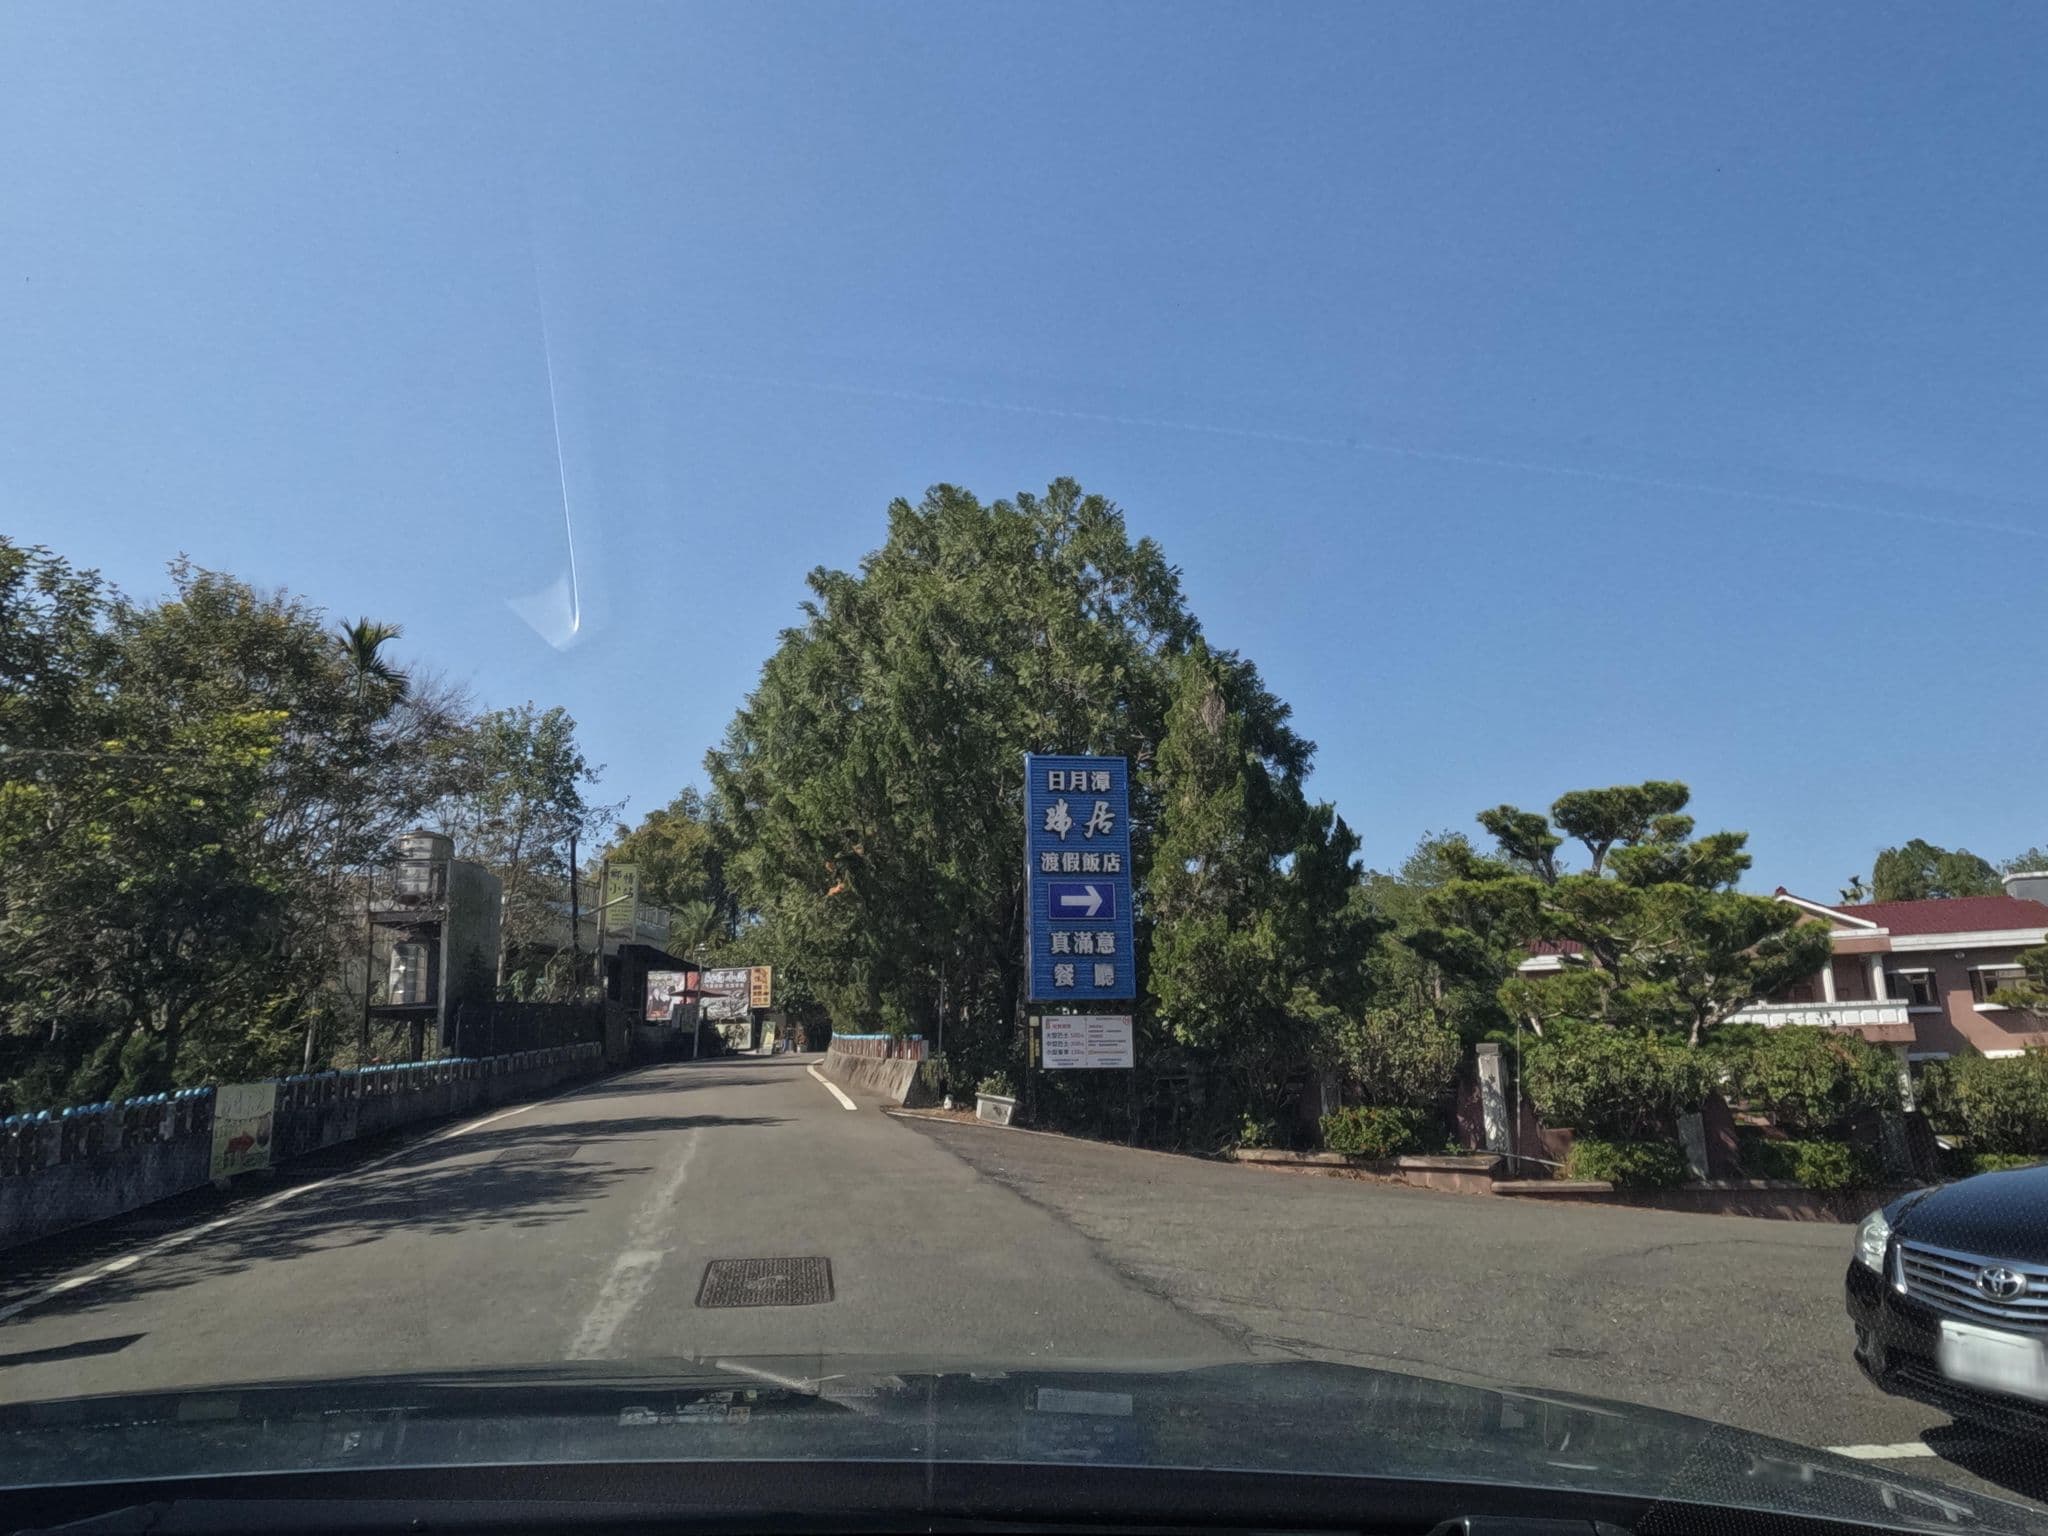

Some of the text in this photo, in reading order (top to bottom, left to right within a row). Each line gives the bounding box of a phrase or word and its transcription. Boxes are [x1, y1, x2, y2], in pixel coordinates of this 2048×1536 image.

[1048, 770, 1111, 792] 日月潭
[1041, 852, 1120, 873] 渡假飯店
[1051, 931, 1116, 955] 真滿意
